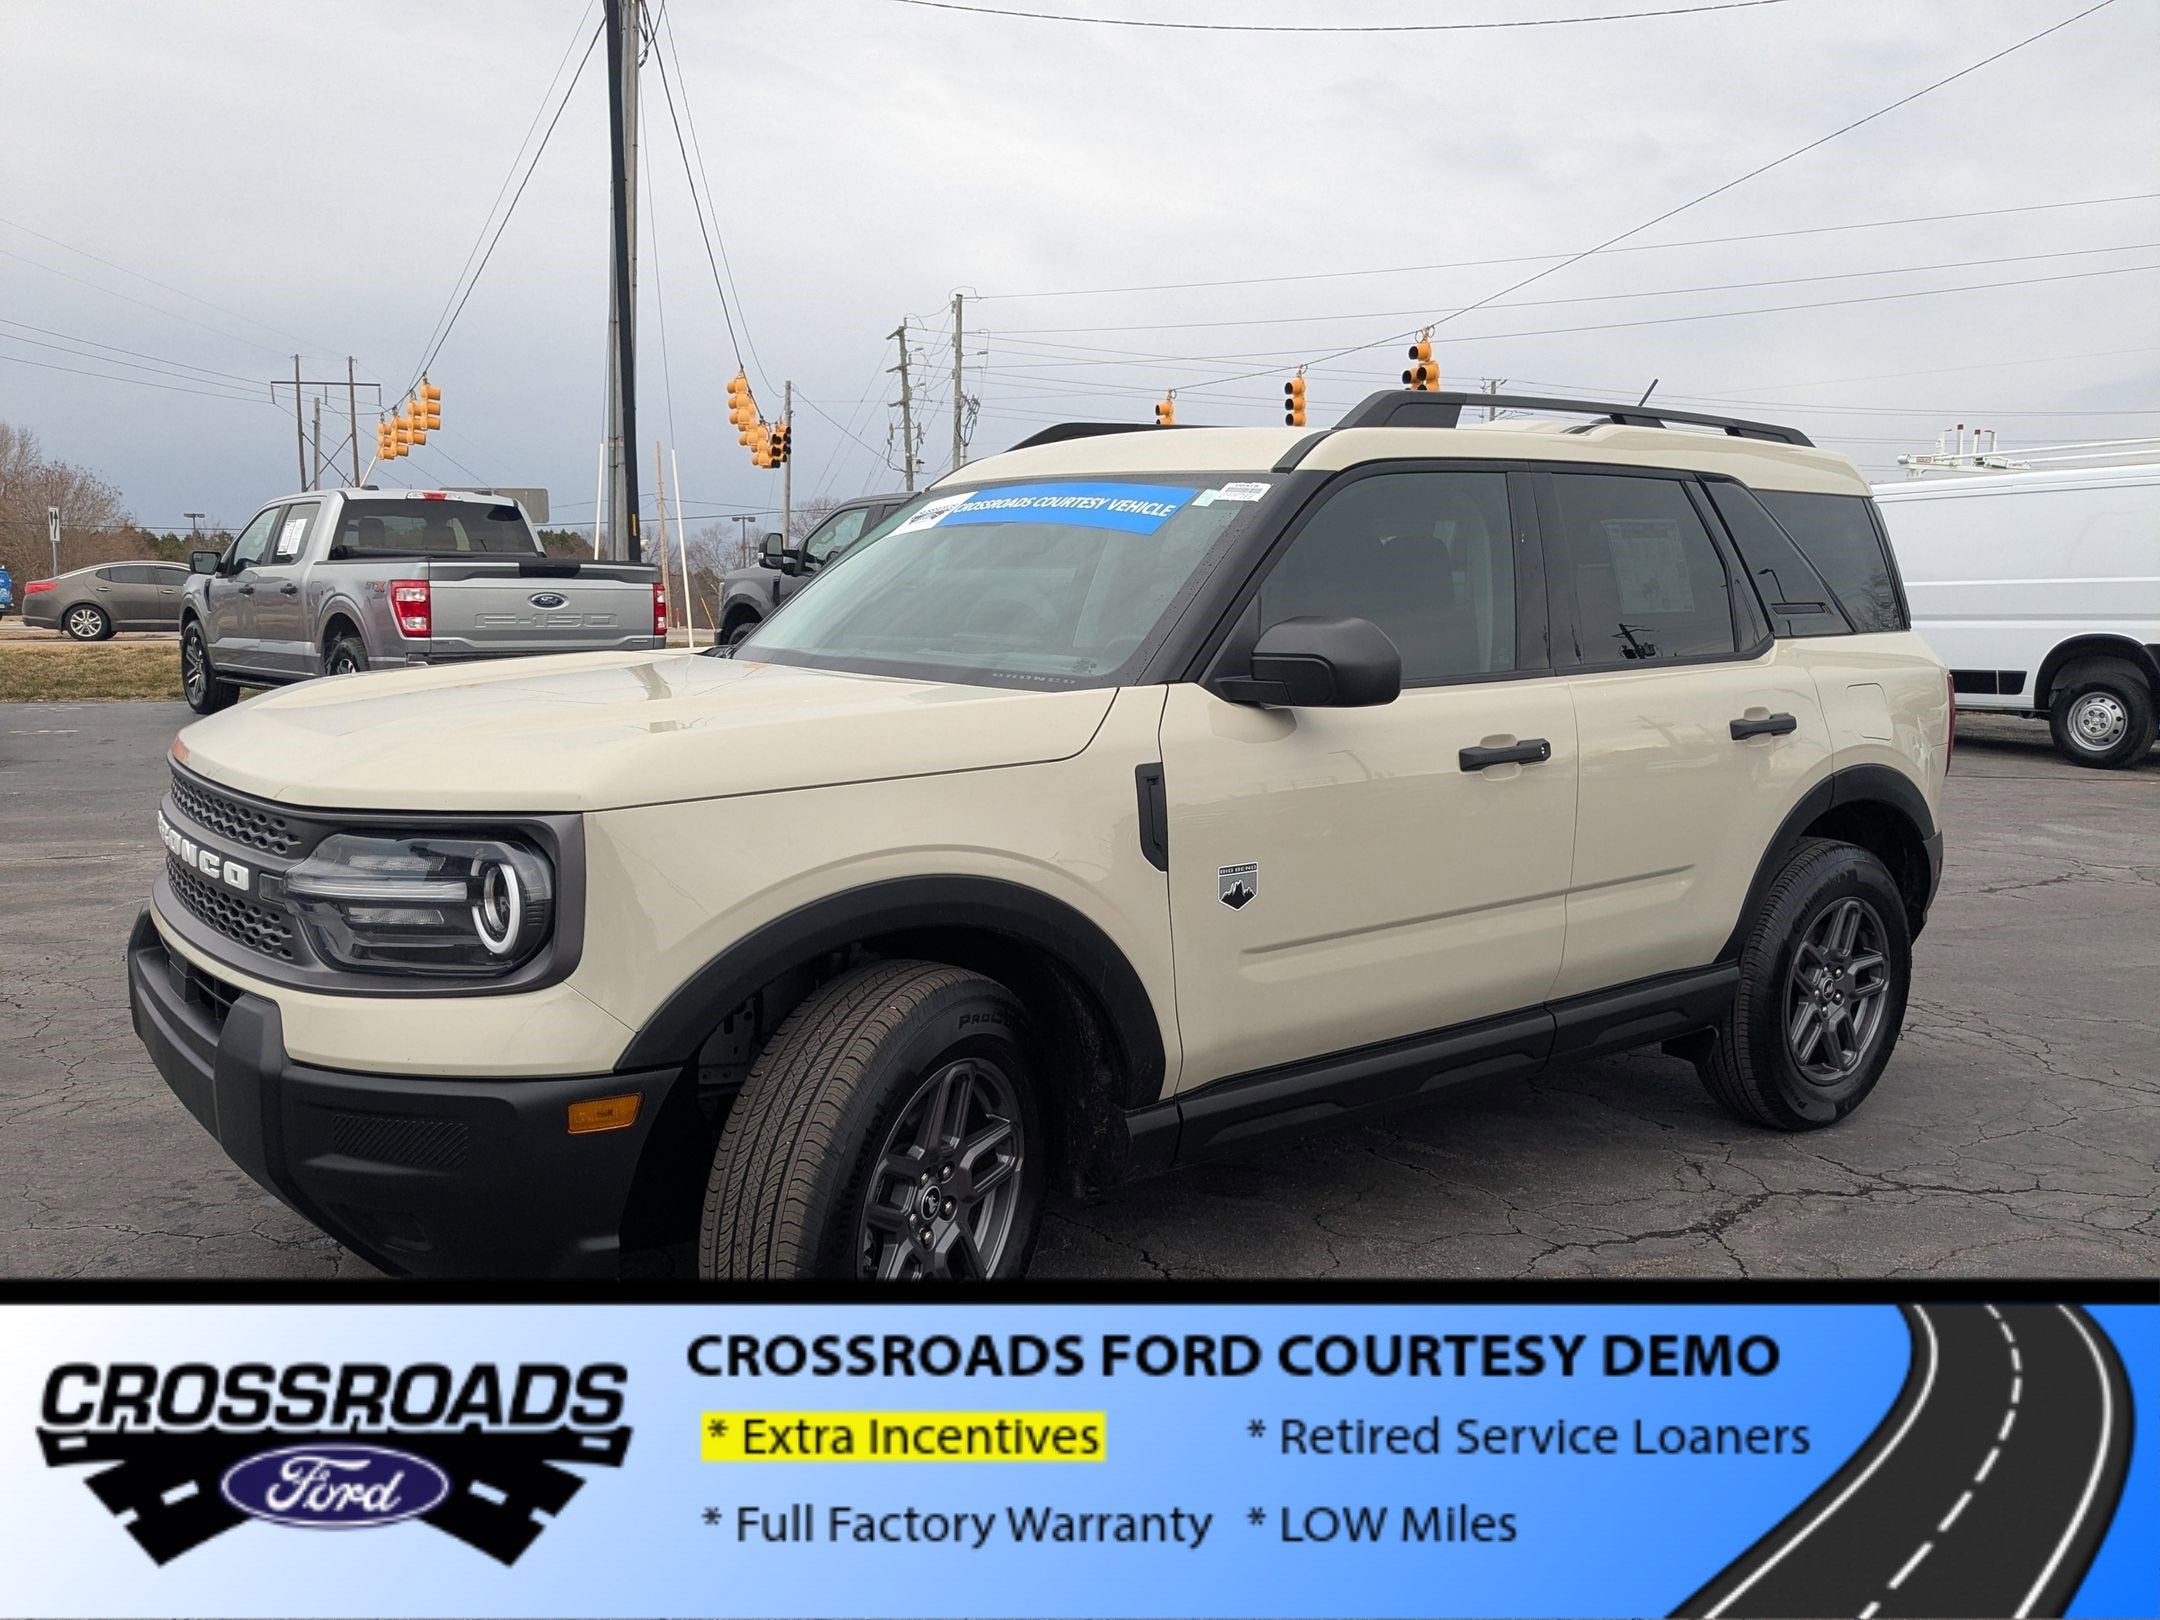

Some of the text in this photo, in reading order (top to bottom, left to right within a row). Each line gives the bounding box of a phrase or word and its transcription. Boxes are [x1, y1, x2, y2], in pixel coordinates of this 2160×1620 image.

[953, 496, 1033, 514] CROSSROADS
[1032, 495, 1107, 510] COURTESY
[1106, 498, 1176, 518] VEHICLE
[474, 613, 619, 628] F-150
[158, 811, 250, 891] RONCO
